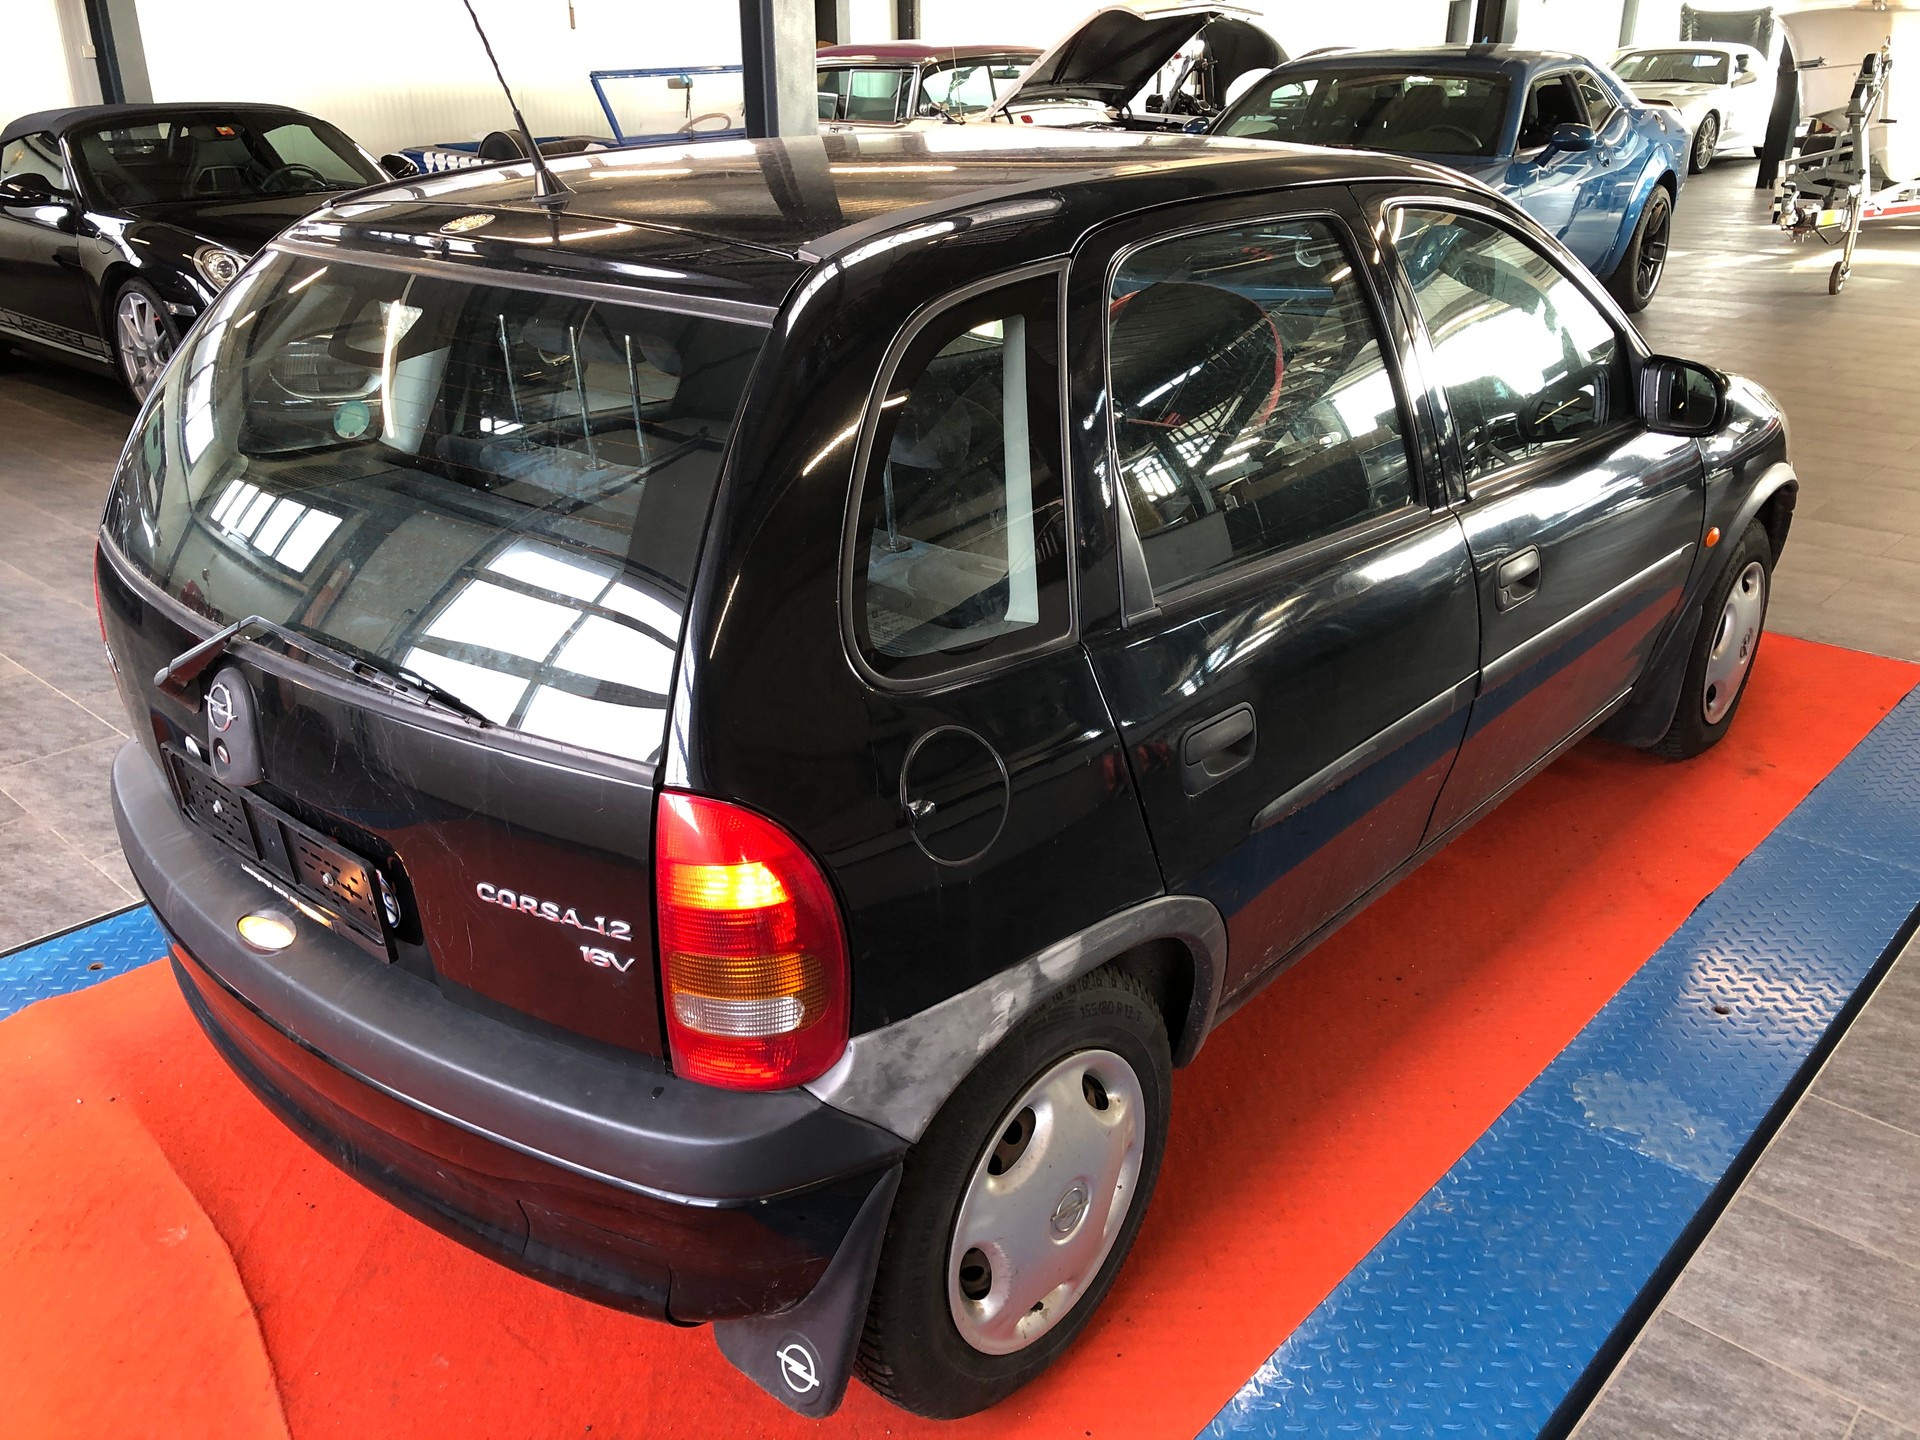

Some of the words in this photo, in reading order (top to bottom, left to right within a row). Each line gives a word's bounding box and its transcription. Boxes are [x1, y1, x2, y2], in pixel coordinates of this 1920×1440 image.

[21, 318, 83, 346] PORSCHE
[476, 882, 584, 930] CORSA
[594, 915, 635, 942] 1.2
[579, 945, 637, 973] 16V
